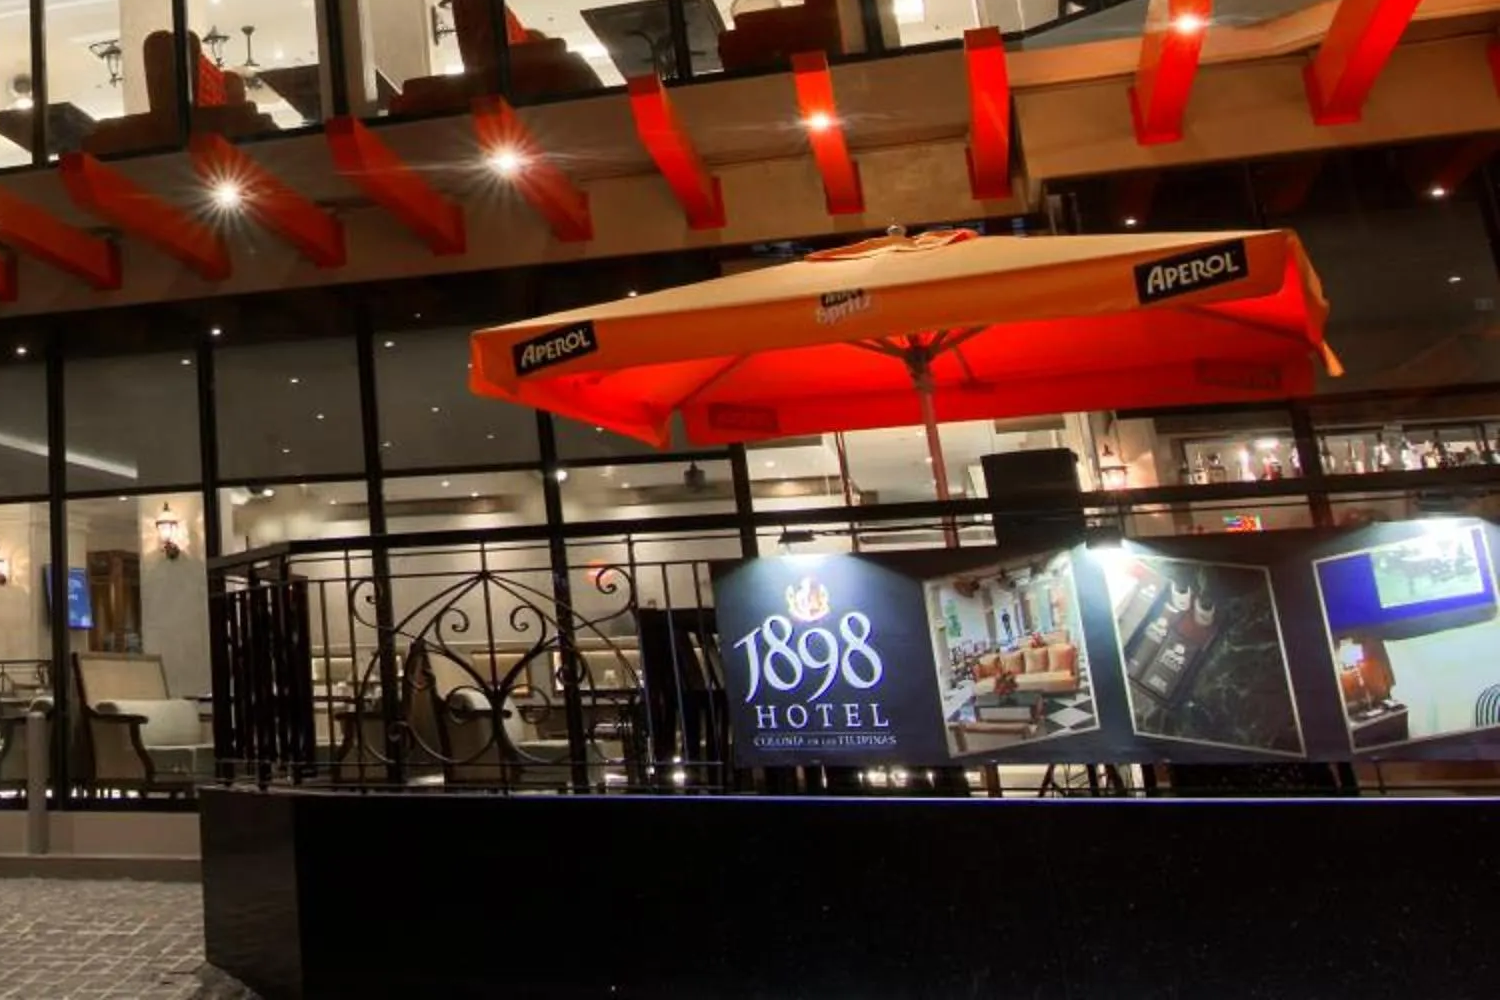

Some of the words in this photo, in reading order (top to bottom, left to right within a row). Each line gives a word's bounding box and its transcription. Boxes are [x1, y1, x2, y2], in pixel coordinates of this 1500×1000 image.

[1146, 251, 1239, 294] APEROL
[521, 328, 591, 368] APEROL
[733, 612, 882, 702] 1898
[755, 703, 889, 729] HOTEL
